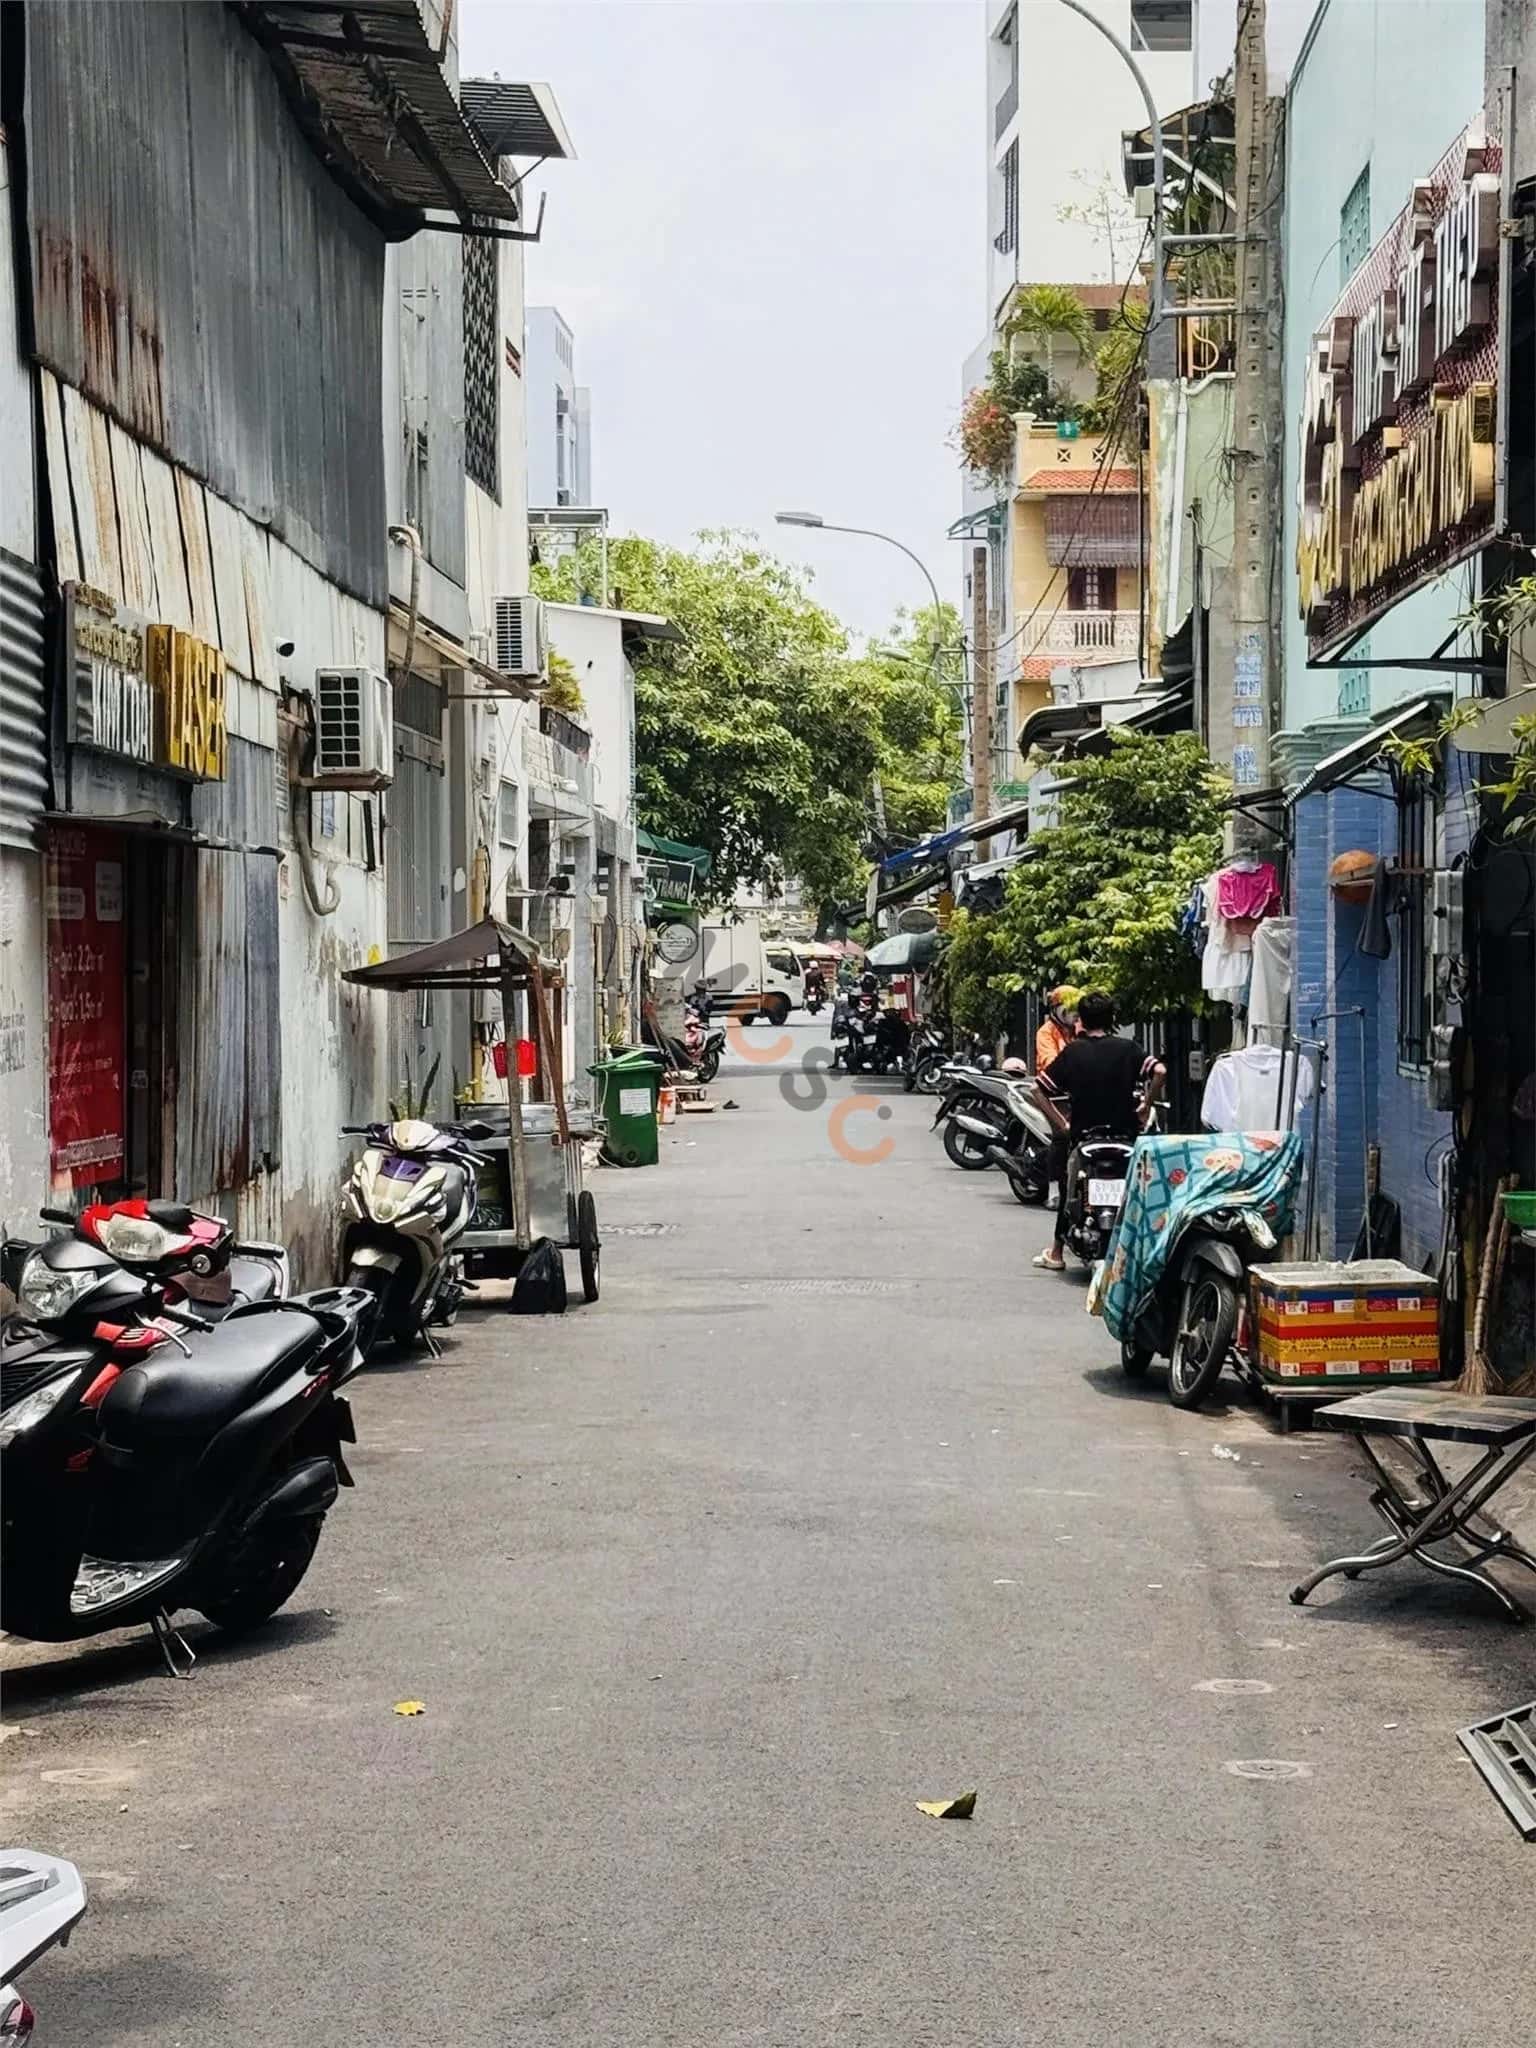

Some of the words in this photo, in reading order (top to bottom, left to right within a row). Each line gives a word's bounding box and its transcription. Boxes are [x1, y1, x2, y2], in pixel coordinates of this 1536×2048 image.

[92, 656, 120, 752] KIM
[168, 625, 229, 781] LASER
[655, 878, 688, 900] TRANG
